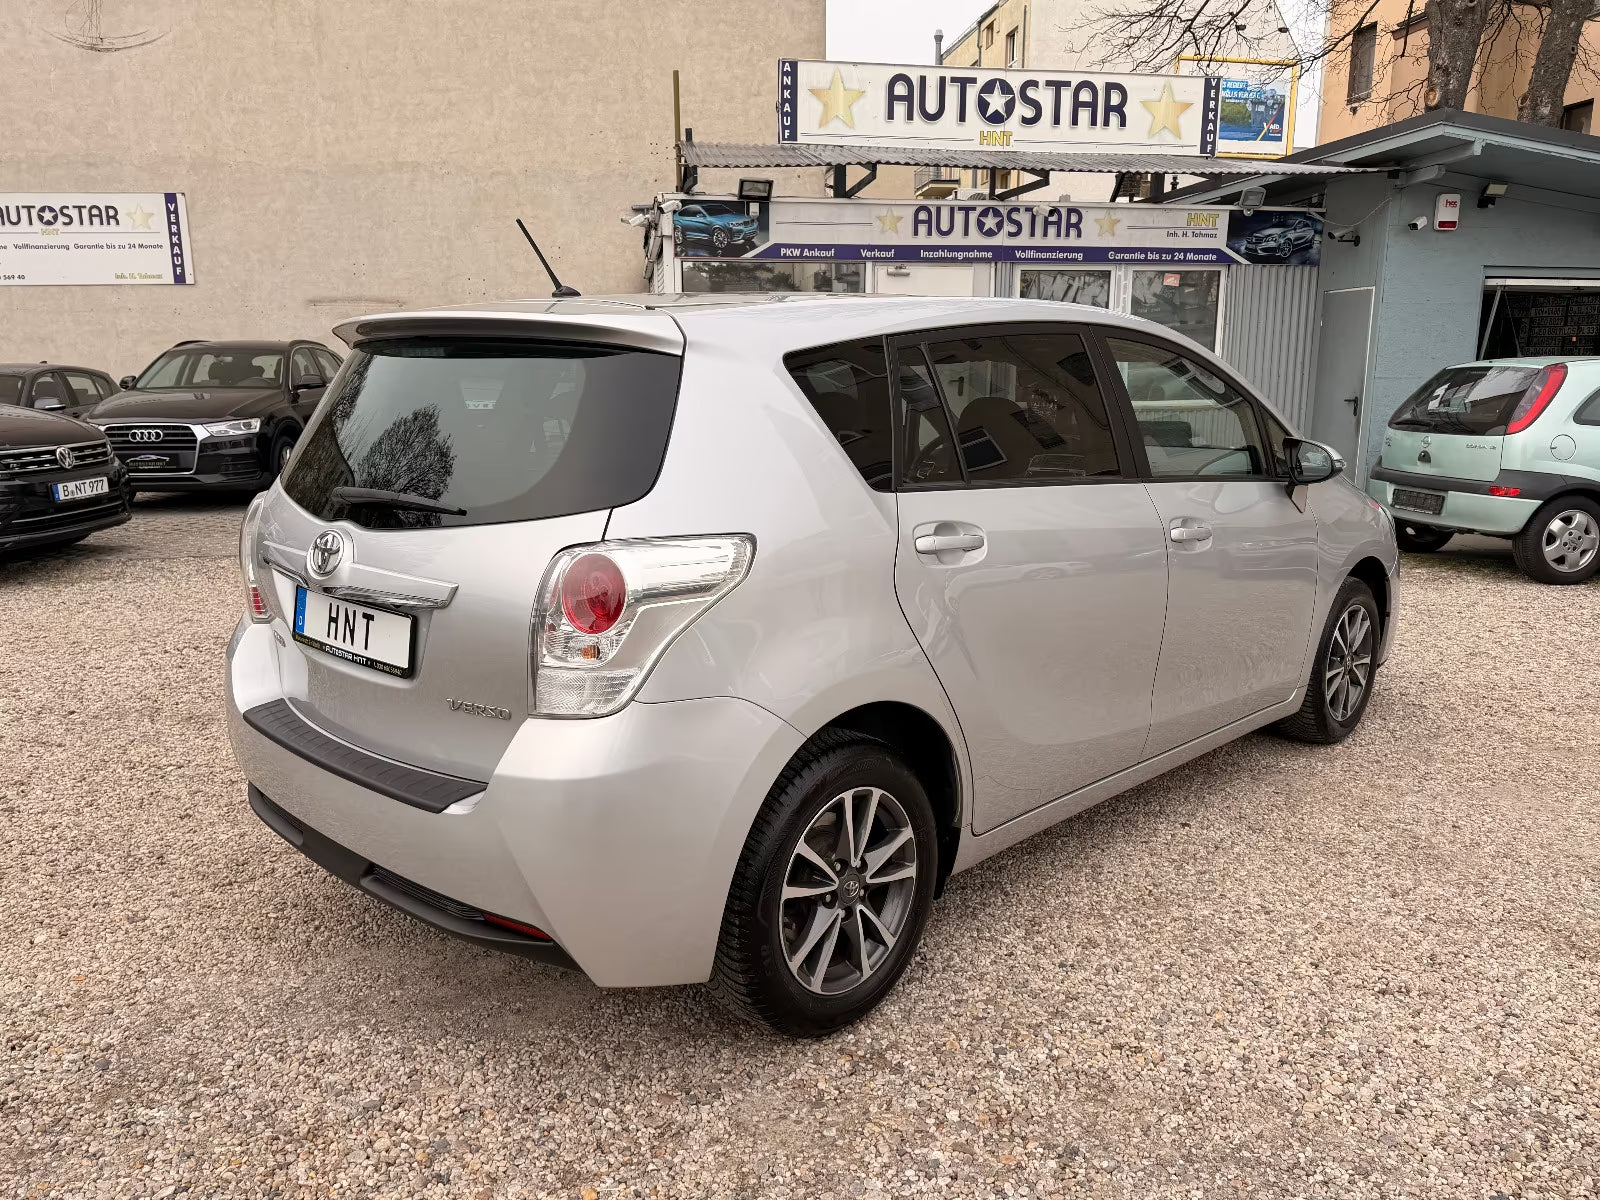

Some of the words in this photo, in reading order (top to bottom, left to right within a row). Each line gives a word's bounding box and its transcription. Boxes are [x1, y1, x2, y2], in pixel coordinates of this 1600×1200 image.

[783, 62, 792, 139] ANKAUF
[886, 73, 1129, 128] AUTOSTAR
[1207, 78, 1218, 152] VERKAUF
[979, 130, 1013, 147] HNT
[913, 205, 1083, 239] AUTOSTAR
[1186, 212, 1219, 227] HNT
[167, 203, 183, 276] VERKAUF
[1166, 230, 1180, 238] Inh.
[13, 242, 70, 251] Vollfinanzierung
[780, 248, 801, 257] PKW
[803, 248, 835, 258] Ankauf
[860, 249, 895, 258] Verkauf
[920, 249, 993, 260] Inzahlungnahme
[1015, 250, 1083, 261] Vollfinanzierung
[1108, 252, 1146, 260] Garantie
[1147, 252, 1160, 260] bis
[1173, 252, 1185, 261] 24
[1186, 252, 1217, 261] Monate
[62, 484, 70, 497] B
[75, 481, 87, 496] NT
[88, 479, 104, 493] 977
[326, 602, 375, 651] HNT
[445, 698, 512, 721] VERSO
